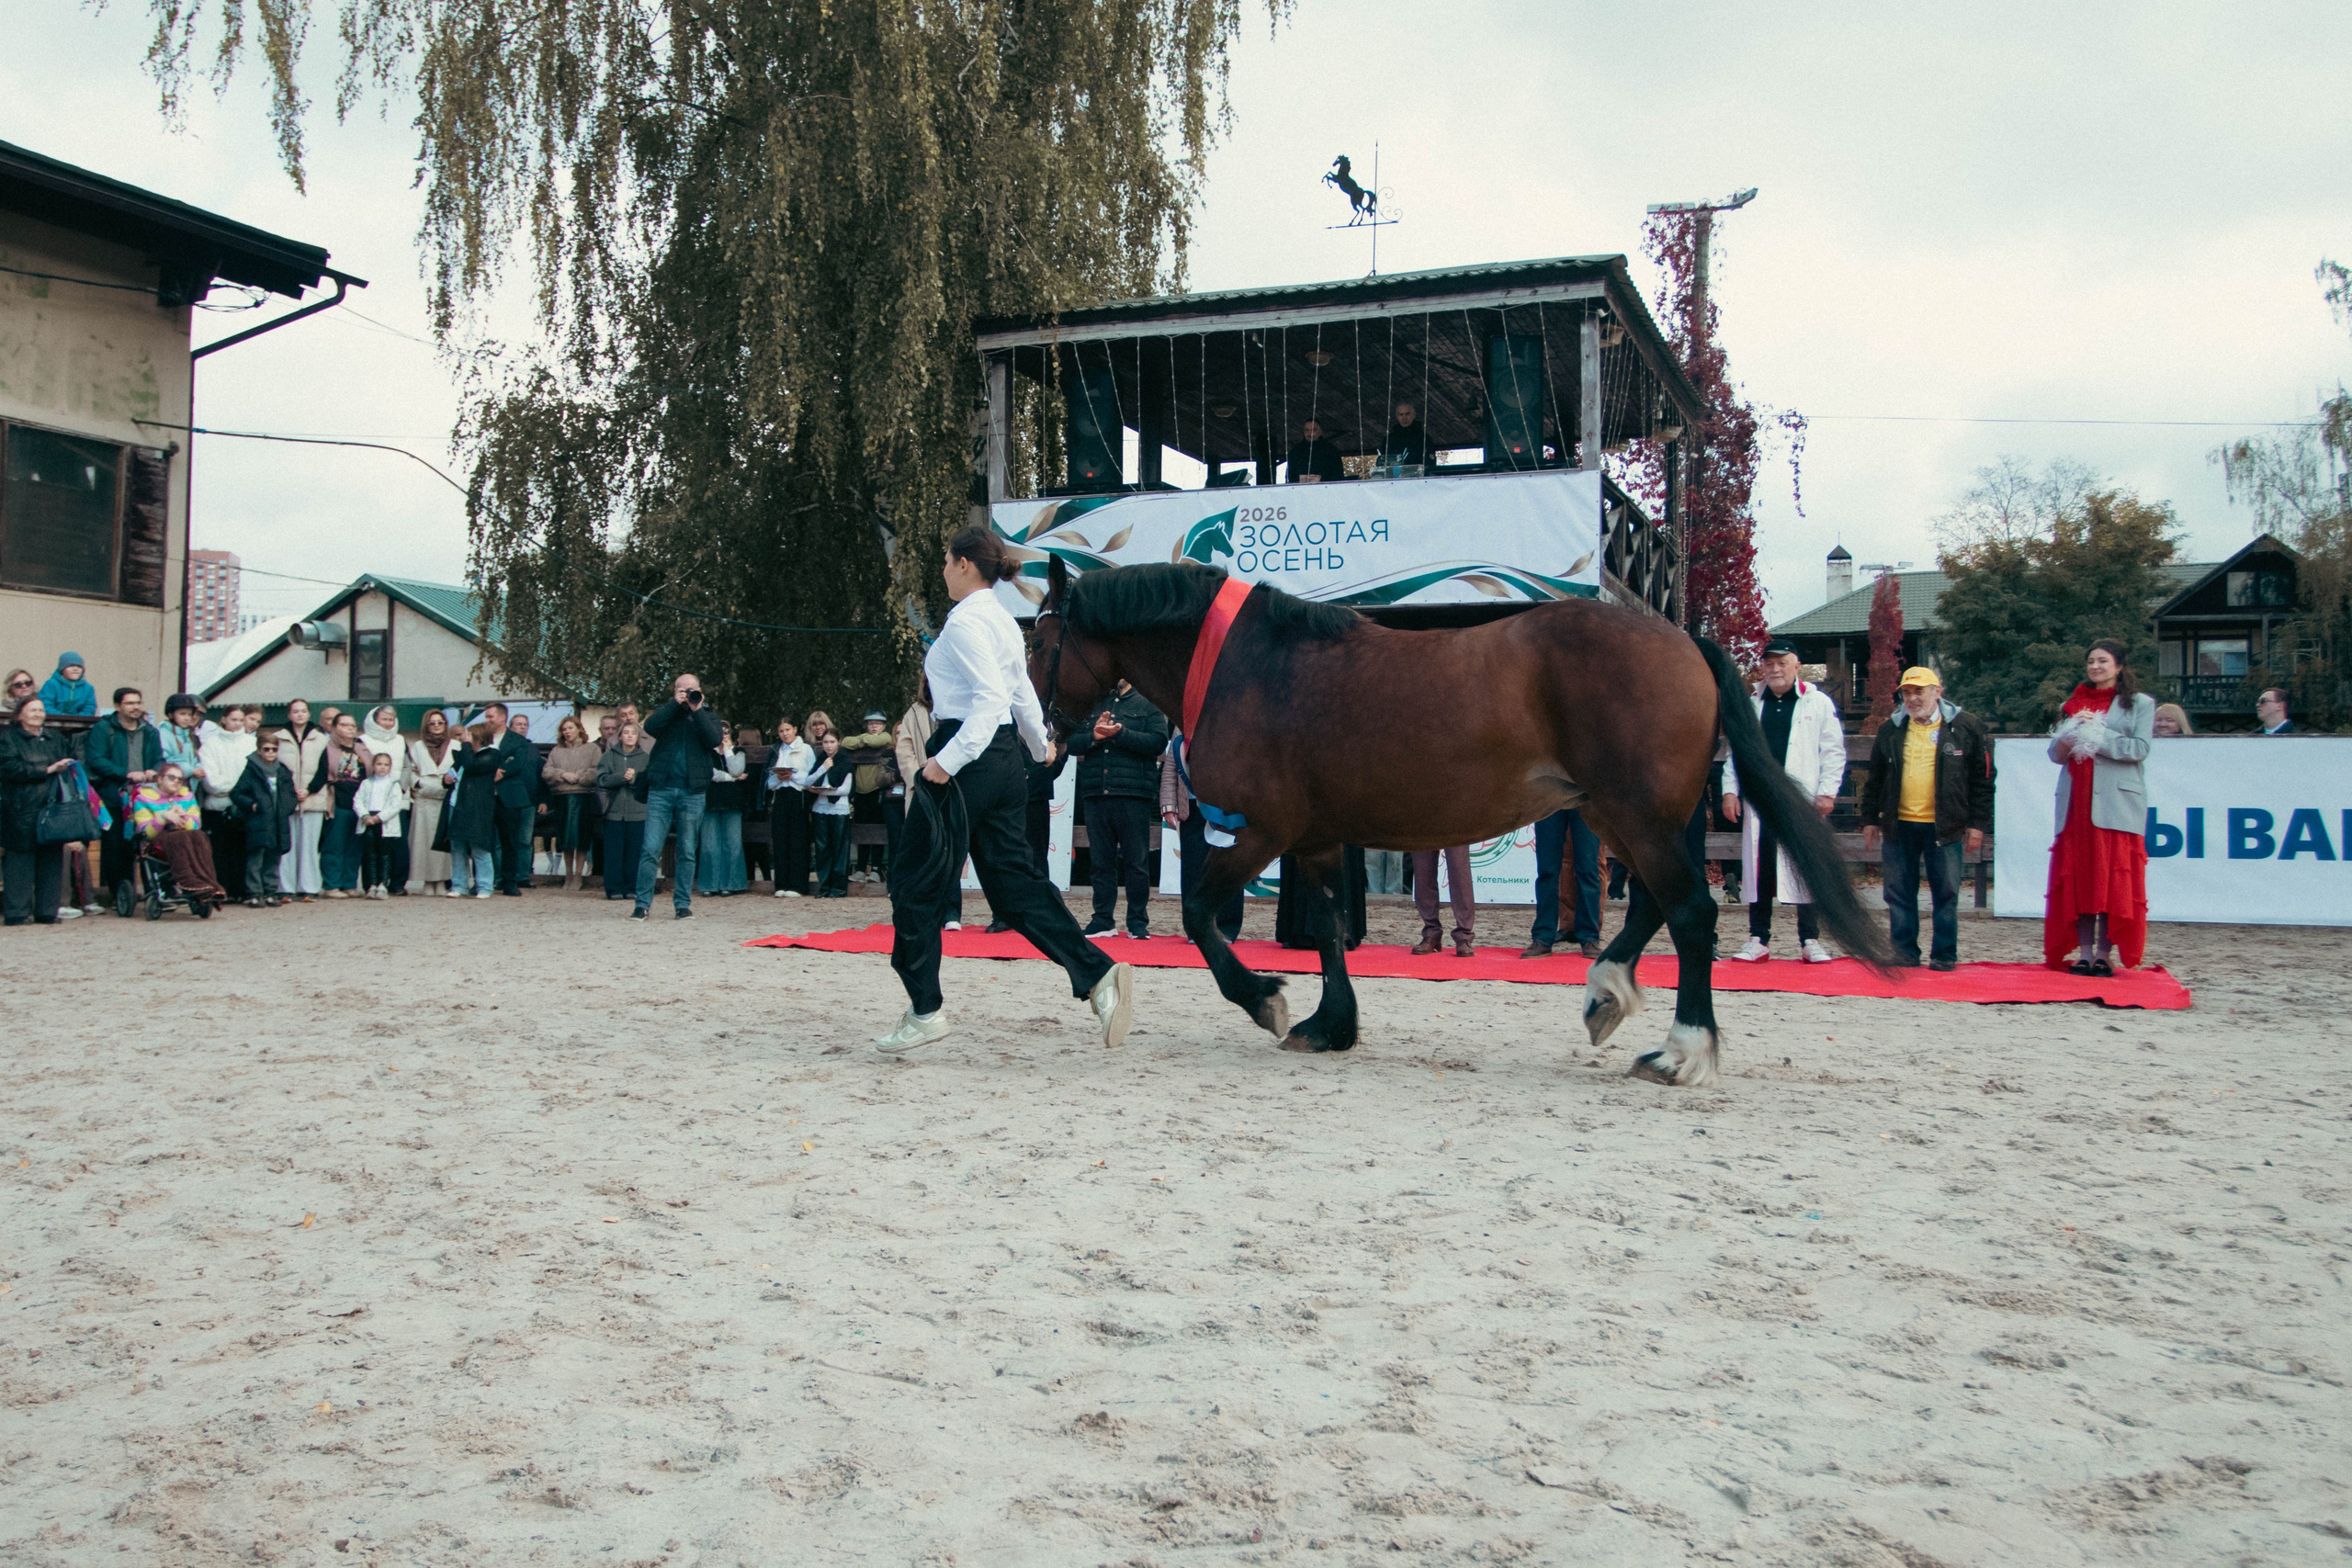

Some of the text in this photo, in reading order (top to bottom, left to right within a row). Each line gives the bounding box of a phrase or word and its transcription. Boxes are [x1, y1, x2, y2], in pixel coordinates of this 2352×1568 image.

[1239, 506, 1287, 523] 2026
[1239, 519, 1389, 548] ЗОЛОТАЯ
[1237, 547, 1344, 573] ОСЕНЬ
[2144, 807, 2352, 861] Ы ВА
[1476, 875, 1530, 885] Котельники
